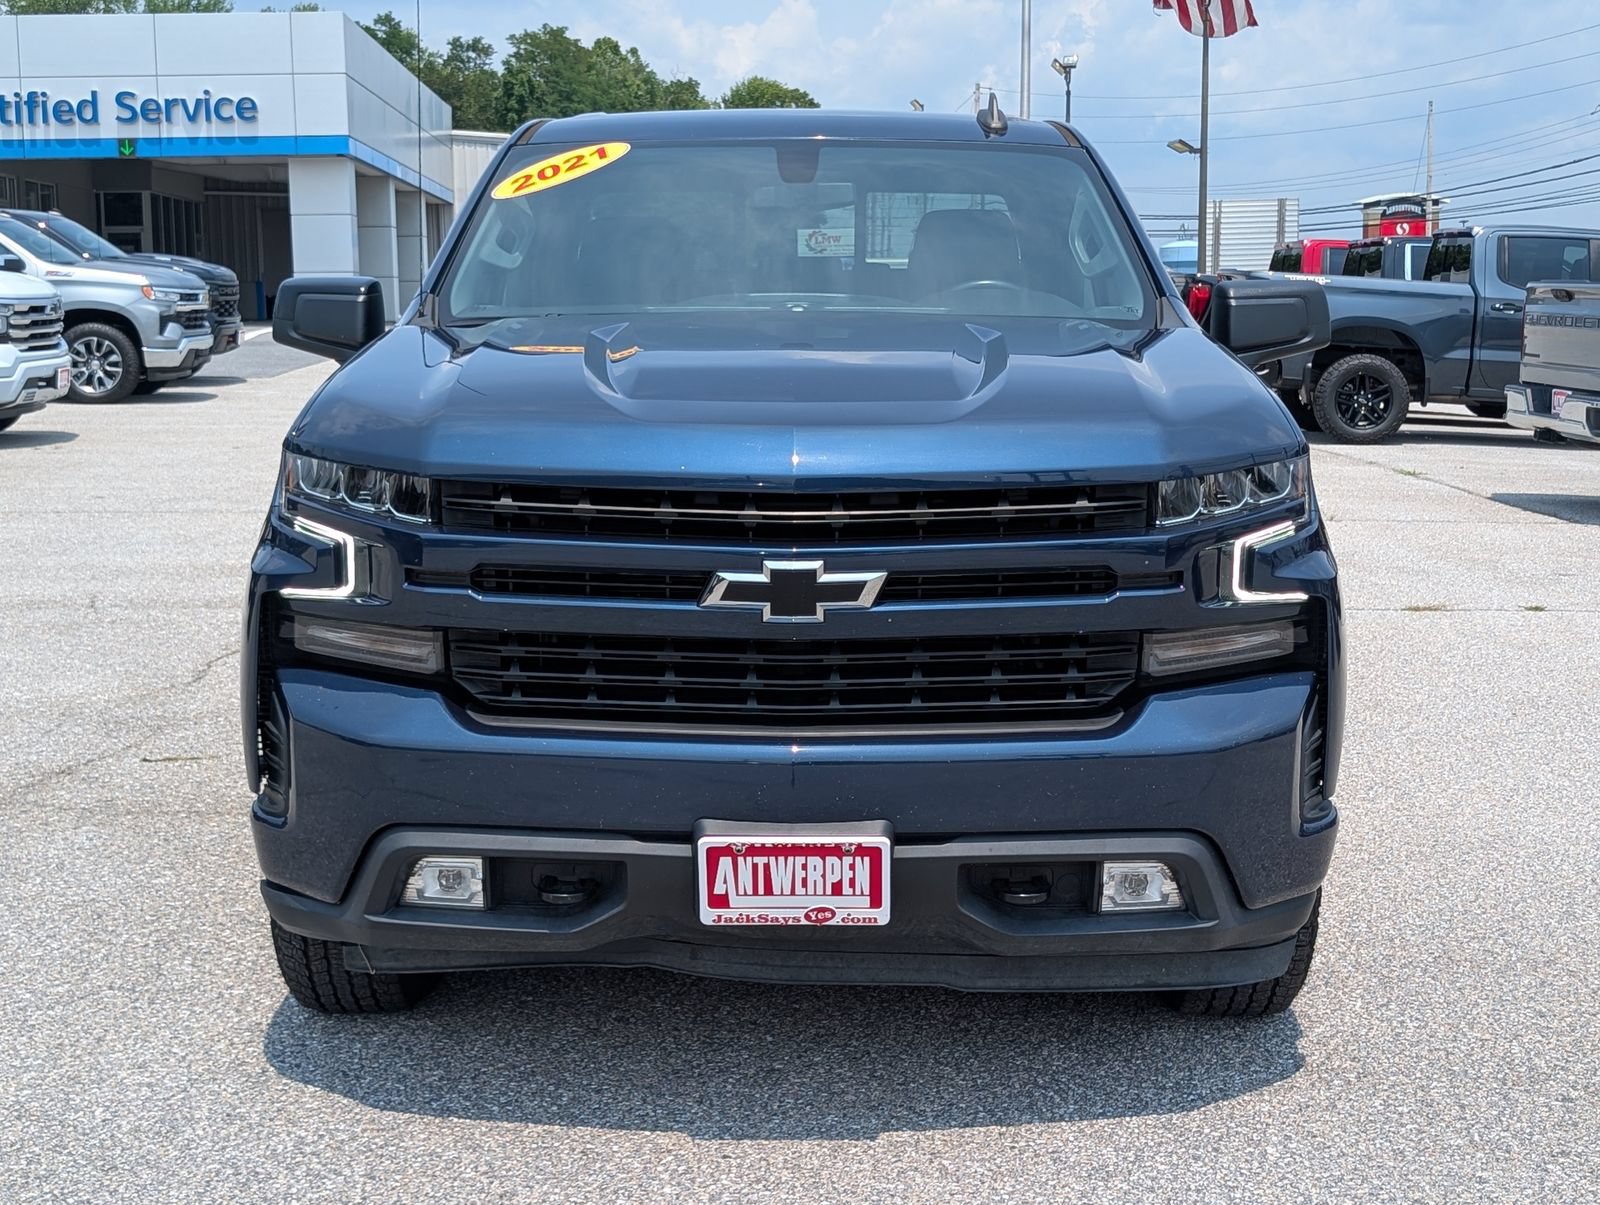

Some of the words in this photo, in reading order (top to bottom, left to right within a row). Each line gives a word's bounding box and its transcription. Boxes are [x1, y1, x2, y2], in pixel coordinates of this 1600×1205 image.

[115, 89, 258, 124] Service
[511, 147, 608, 194] 2021
[713, 856, 871, 897] ANTWERPEN
[809, 909, 833, 921] Yes
